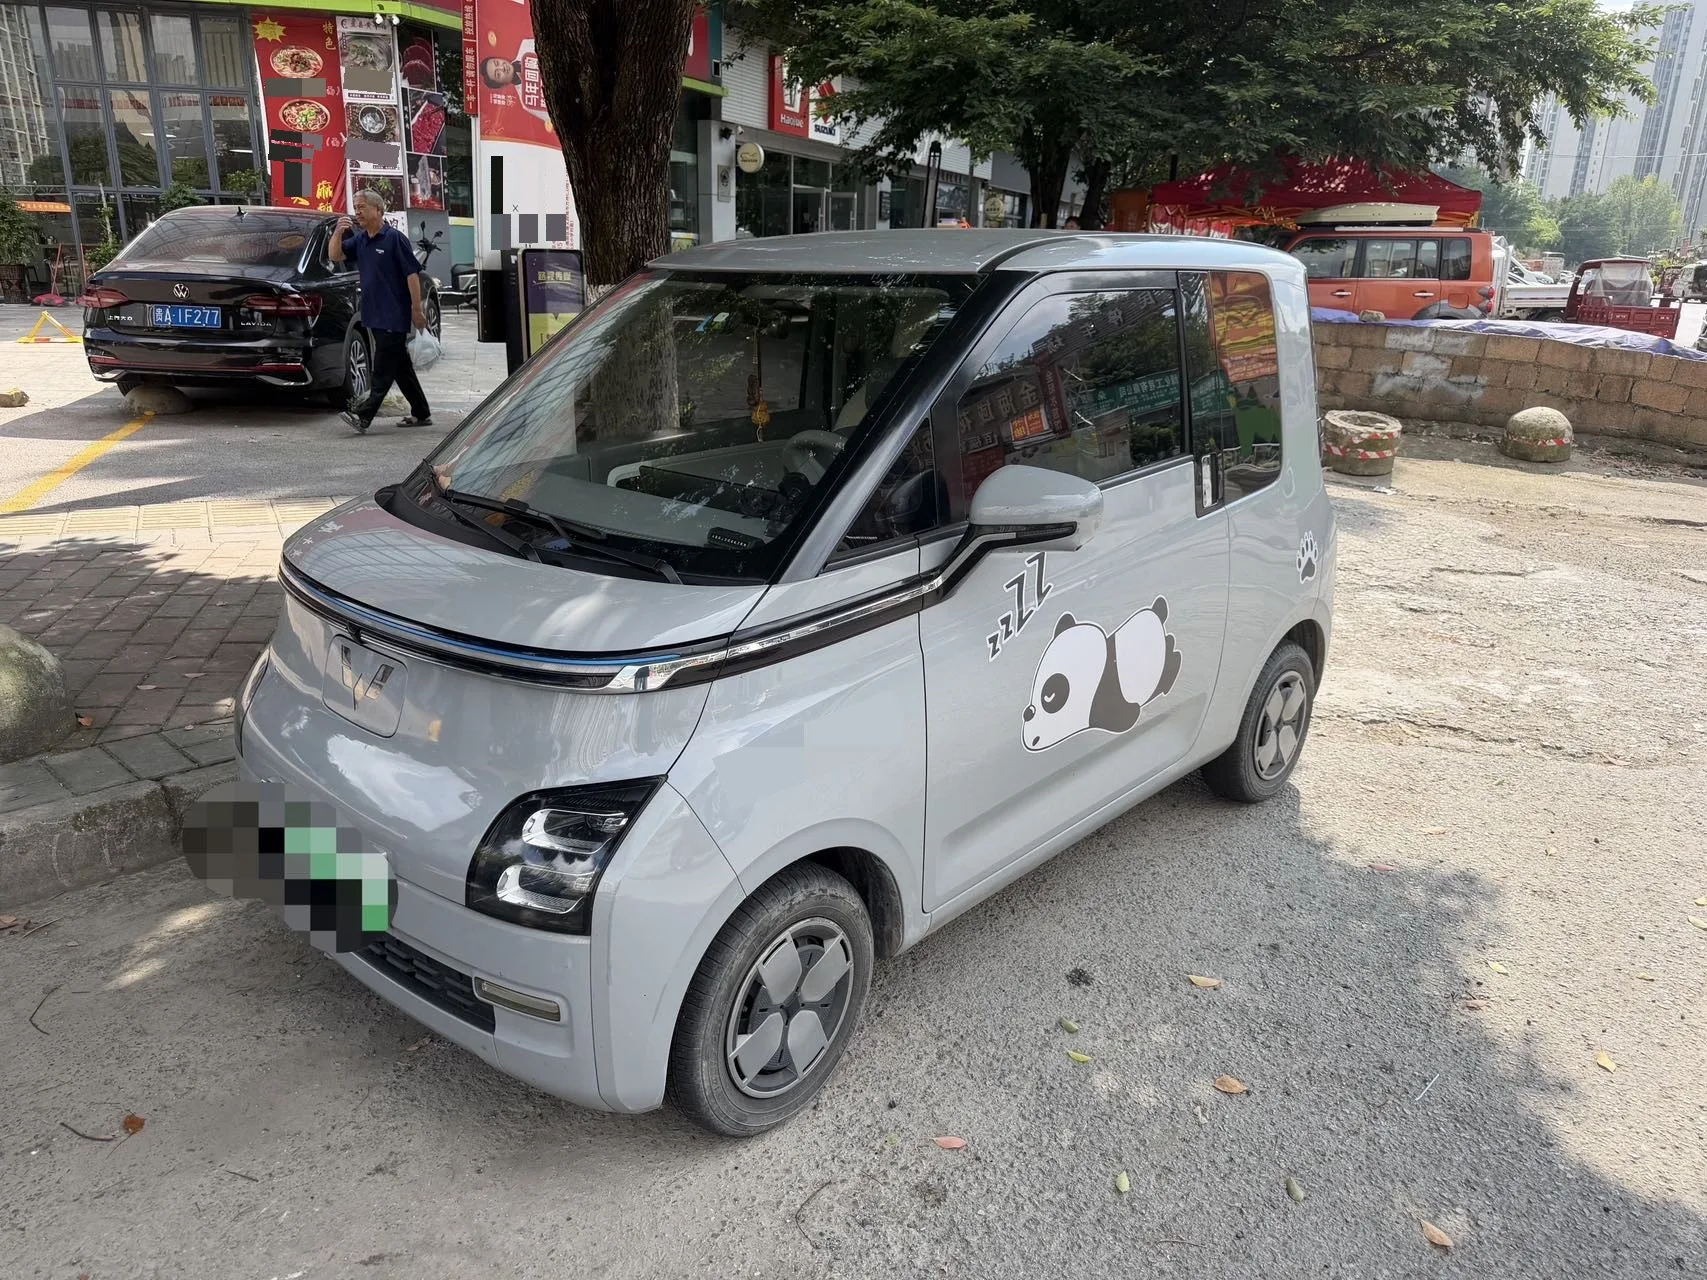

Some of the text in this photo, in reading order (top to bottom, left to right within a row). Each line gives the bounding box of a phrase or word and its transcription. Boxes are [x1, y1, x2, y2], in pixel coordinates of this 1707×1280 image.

[323, 22, 336, 50] 特色
[525, 56, 540, 106] 马年团购
[814, 124, 836, 136] SUZUKI
